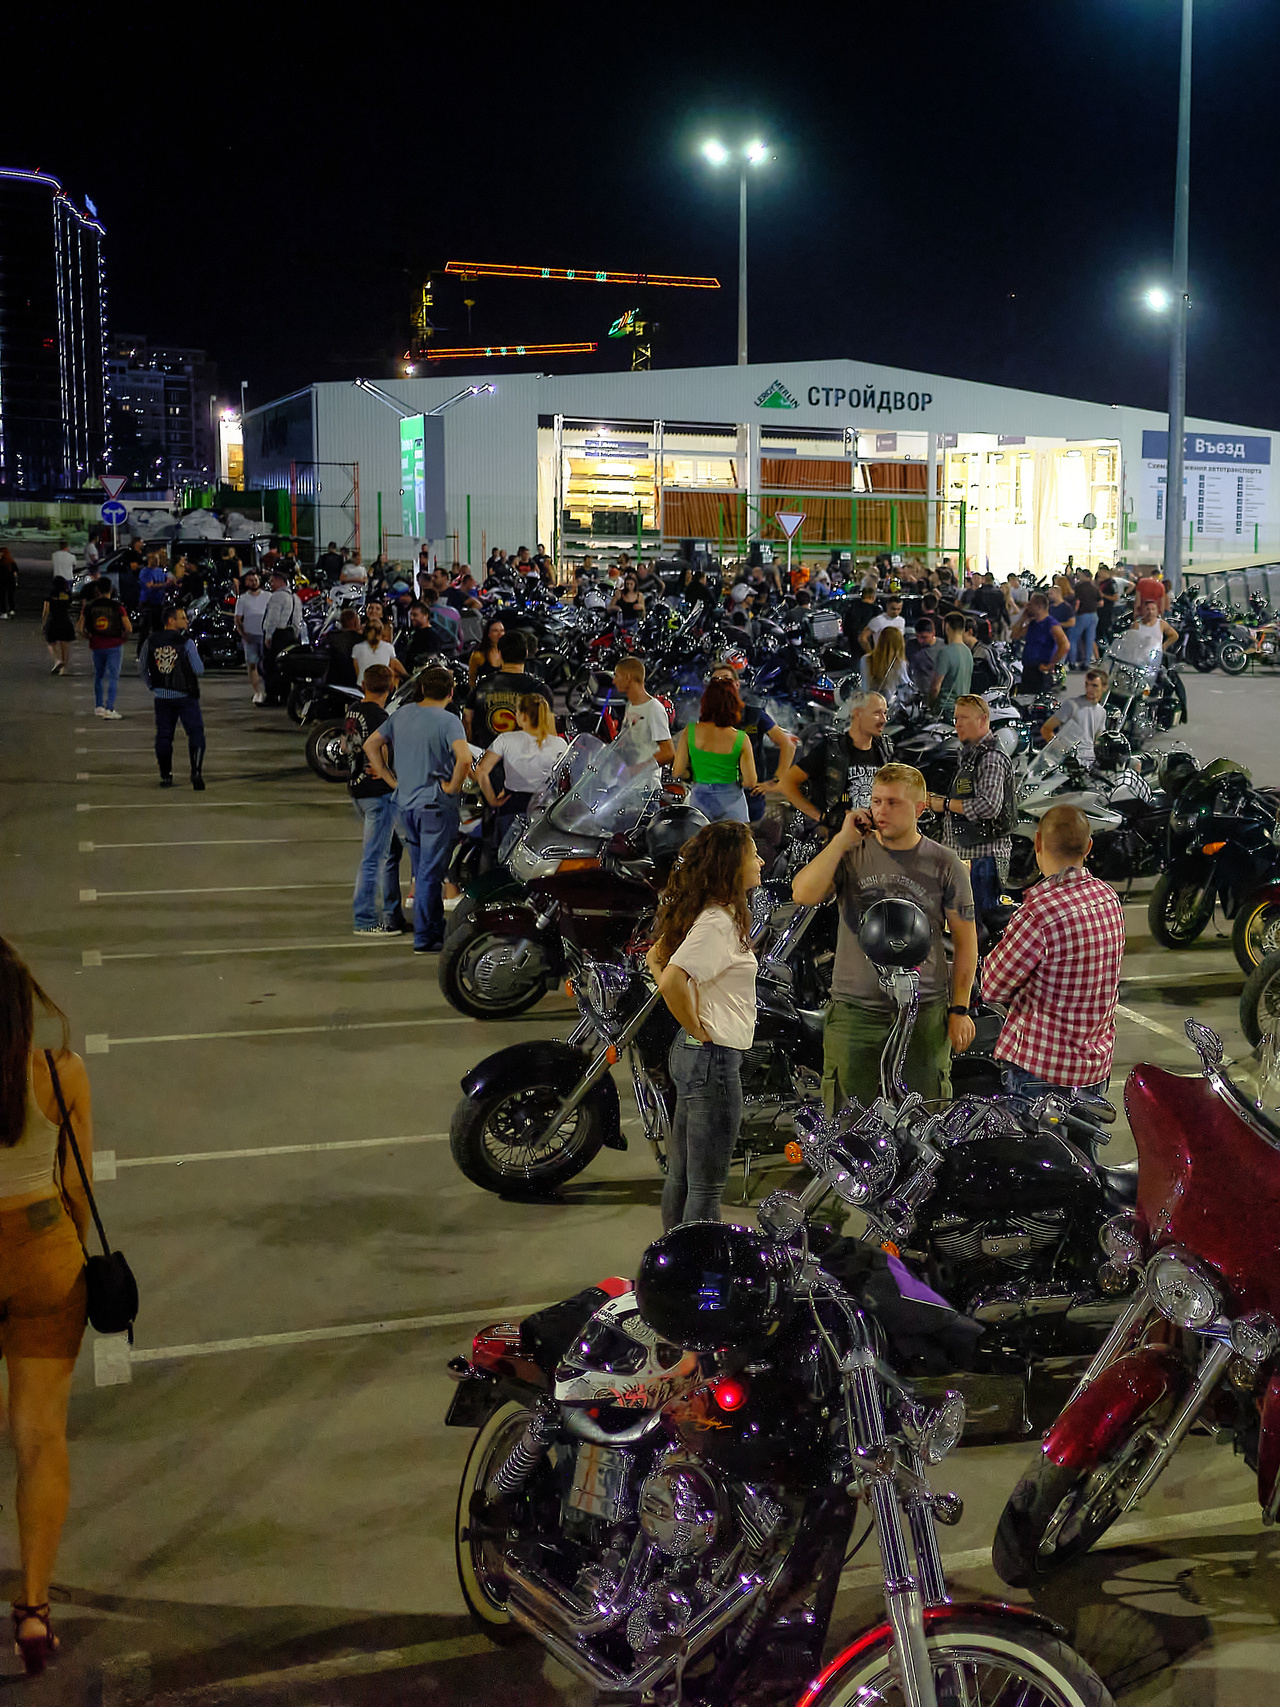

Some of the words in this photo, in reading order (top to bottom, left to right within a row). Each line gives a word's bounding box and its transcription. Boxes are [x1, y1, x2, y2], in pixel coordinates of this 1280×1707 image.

[754, 384, 777, 407] LEROY
[774, 379, 800, 409] MERLIN
[807, 384, 933, 414] СТРОЙДВОР
[1195, 438, 1245, 458] Въезд
[1147, 462, 1168, 470] Схем
